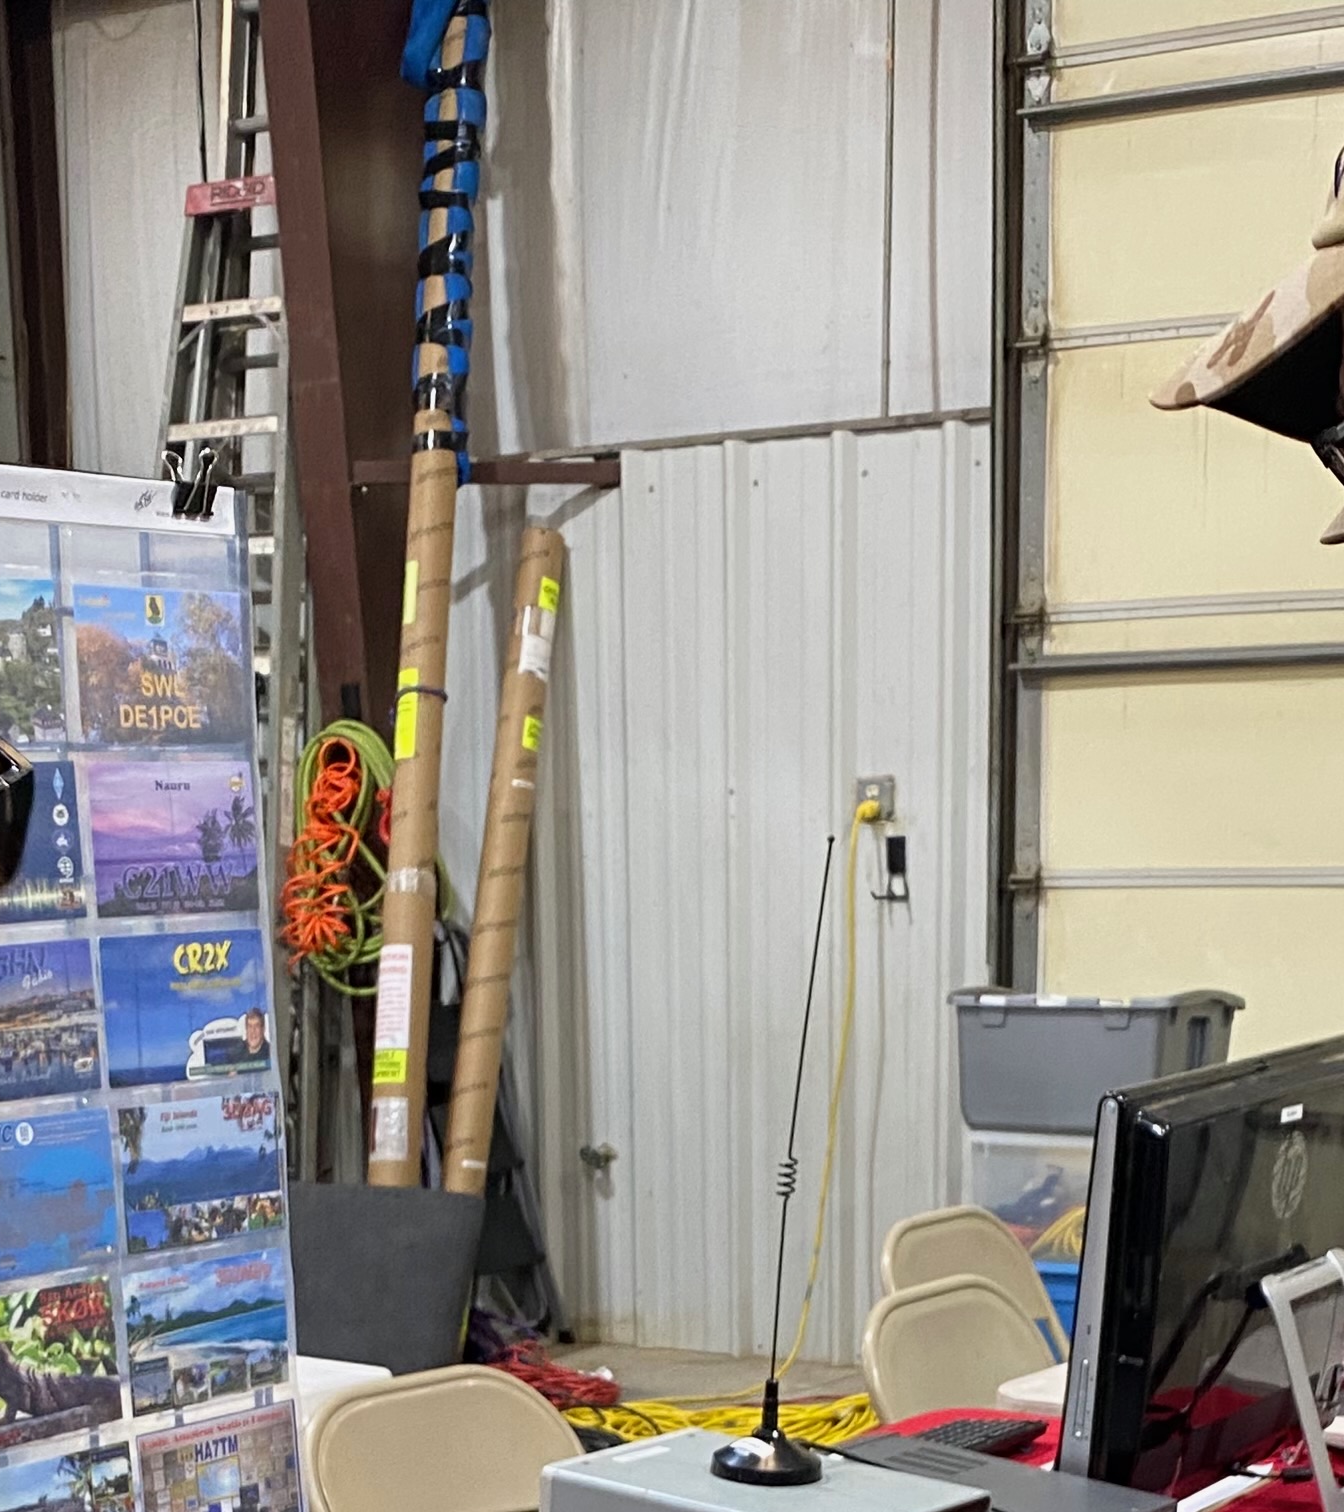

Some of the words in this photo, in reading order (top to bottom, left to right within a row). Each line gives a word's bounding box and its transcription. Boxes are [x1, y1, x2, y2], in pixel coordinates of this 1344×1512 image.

[1, 488, 21, 501] card
[22, 490, 49, 503] holder
[141, 672, 188, 699] SWL
[155, 779, 191, 792] Nauru
[172, 939, 232, 976] CR2X
[194, 1434, 239, 1463] HA7TM
